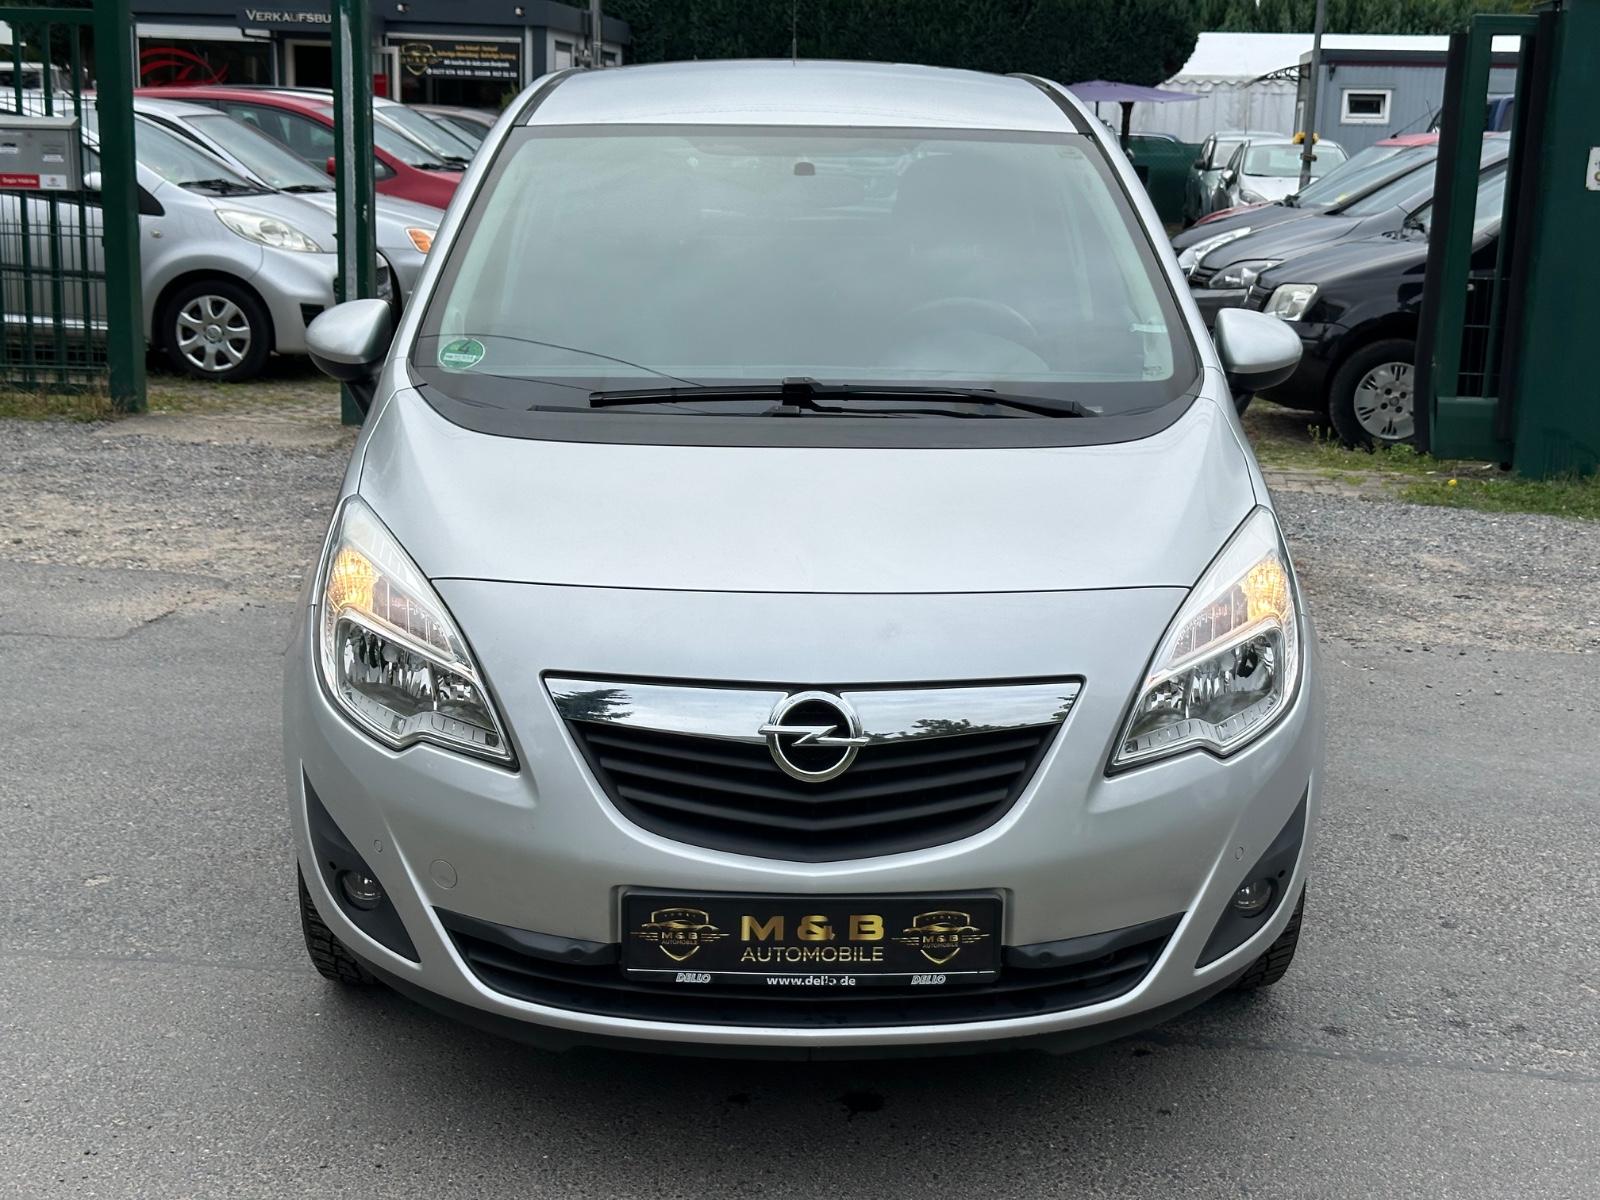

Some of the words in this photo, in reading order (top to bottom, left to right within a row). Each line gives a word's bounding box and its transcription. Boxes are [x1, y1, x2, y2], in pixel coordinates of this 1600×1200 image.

[740, 915, 785, 941] M
[797, 914, 836, 941] &
[848, 914, 885, 941] B
[661, 931, 673, 939] M
[688, 931, 698, 940] B
[740, 946, 884, 963] AUTOMOBILE
[675, 972, 712, 984] DELLO
[910, 974, 947, 986] DELLO
